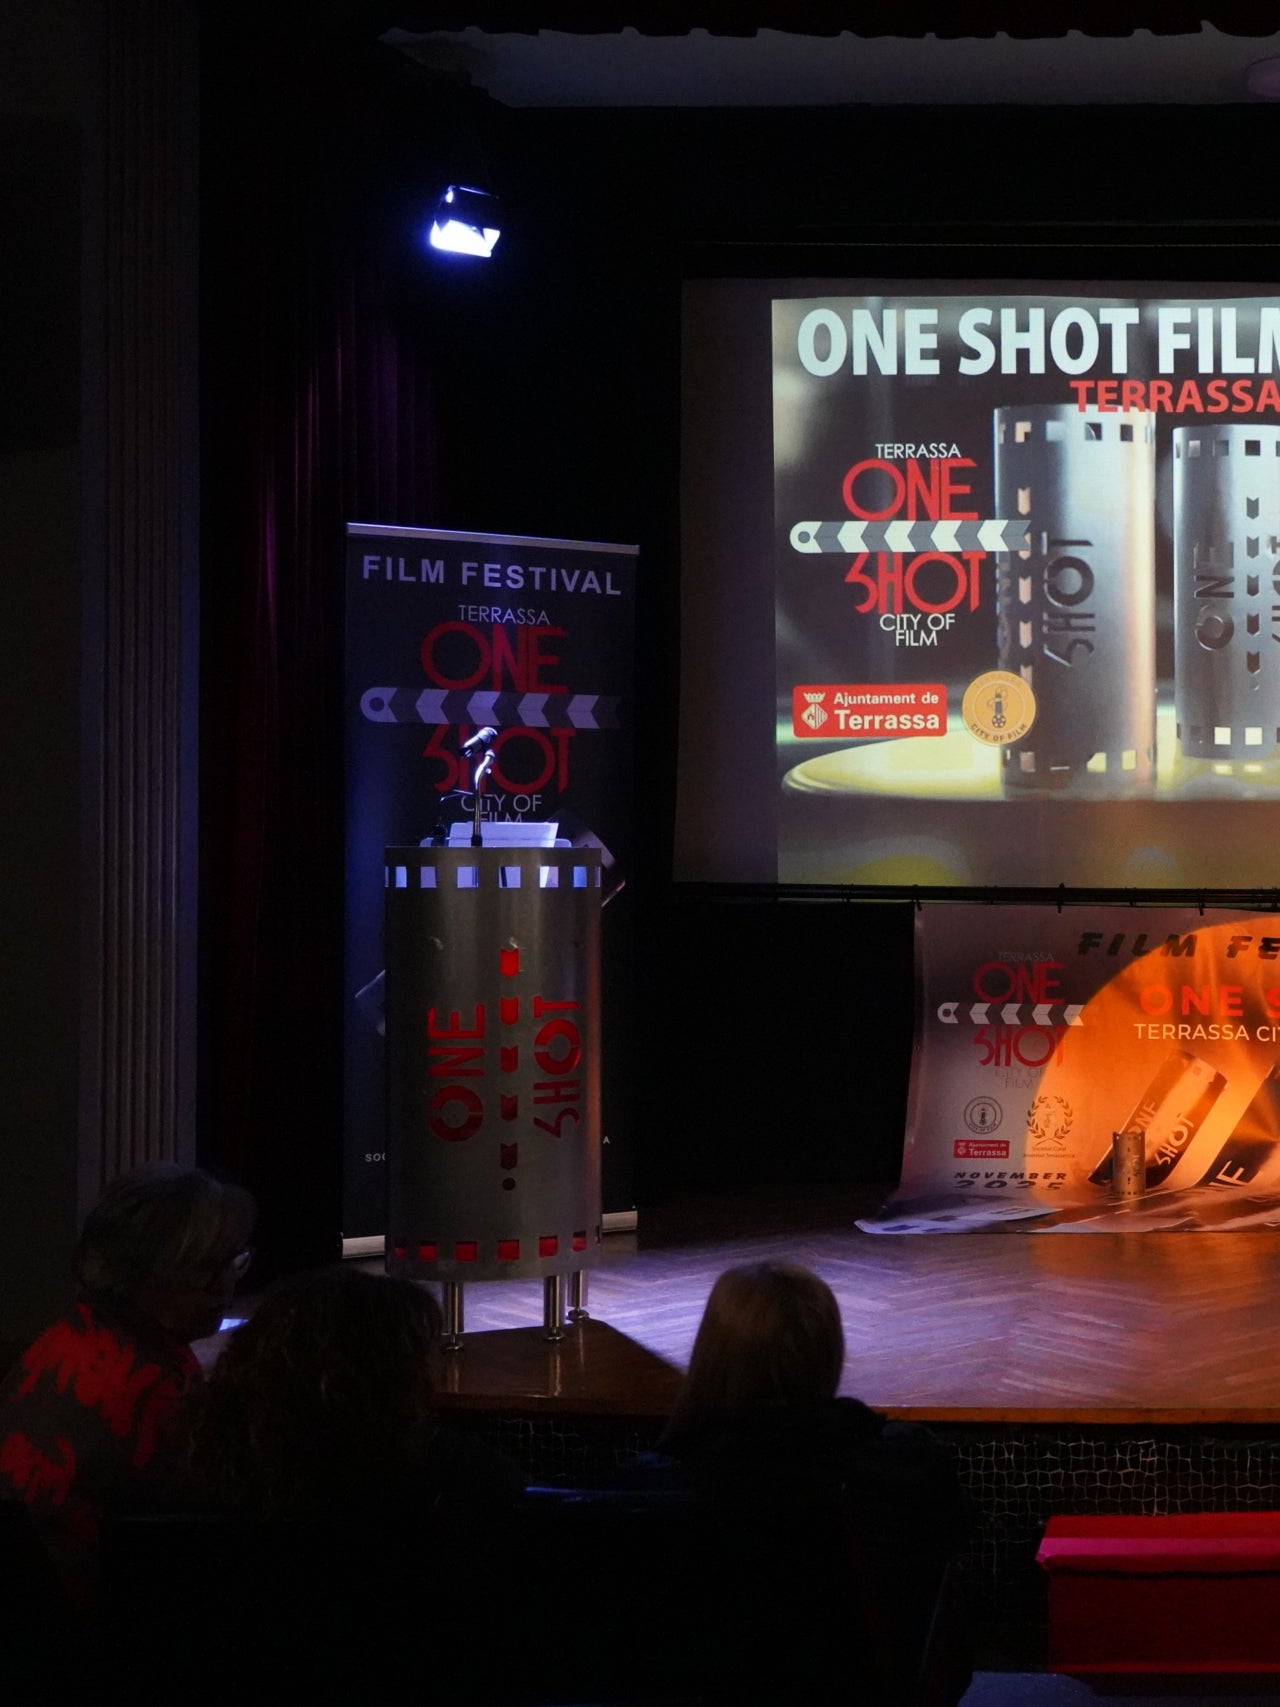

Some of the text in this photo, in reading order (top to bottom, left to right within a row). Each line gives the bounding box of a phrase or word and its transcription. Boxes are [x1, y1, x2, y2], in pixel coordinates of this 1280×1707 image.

[797, 308, 940, 376] ONE
[958, 307, 1139, 376] SHOT
[875, 443, 962, 459] TERRASSA
[842, 457, 979, 521] ONE
[362, 555, 621, 596] FILM FESTIVAL
[844, 551, 986, 614] SHOT
[1043, 531, 1095, 667] SHOT
[1194, 541, 1234, 652] ONE
[458, 604, 550, 625] TERRASSA
[879, 613, 956, 631] CITY OF
[895, 630, 939, 647] FILM
[421, 621, 569, 694] ONE
[834, 691, 939, 706] Ajuntament de
[834, 710, 940, 731] Terrassa
[971, 723, 990, 739] CITY
[1007, 723, 1027, 740] FILM
[513, 794, 542, 812] OF
[1078, 932, 1198, 958] FILM
[973, 961, 1065, 1005] ONE
[1139, 985, 1244, 1018] ONE
[1133, 1023, 1250, 1040] TERRASSA
[971, 1025, 1071, 1067] SHOT
[427, 995, 582, 1143] ONE SHOT
[1154, 1112, 1195, 1166] SHOT
[968, 1148, 1007, 1157] Terrassa
[953, 1172, 1068, 1180] NOVEMBER
[954, 1180, 1063, 1190] 2025
